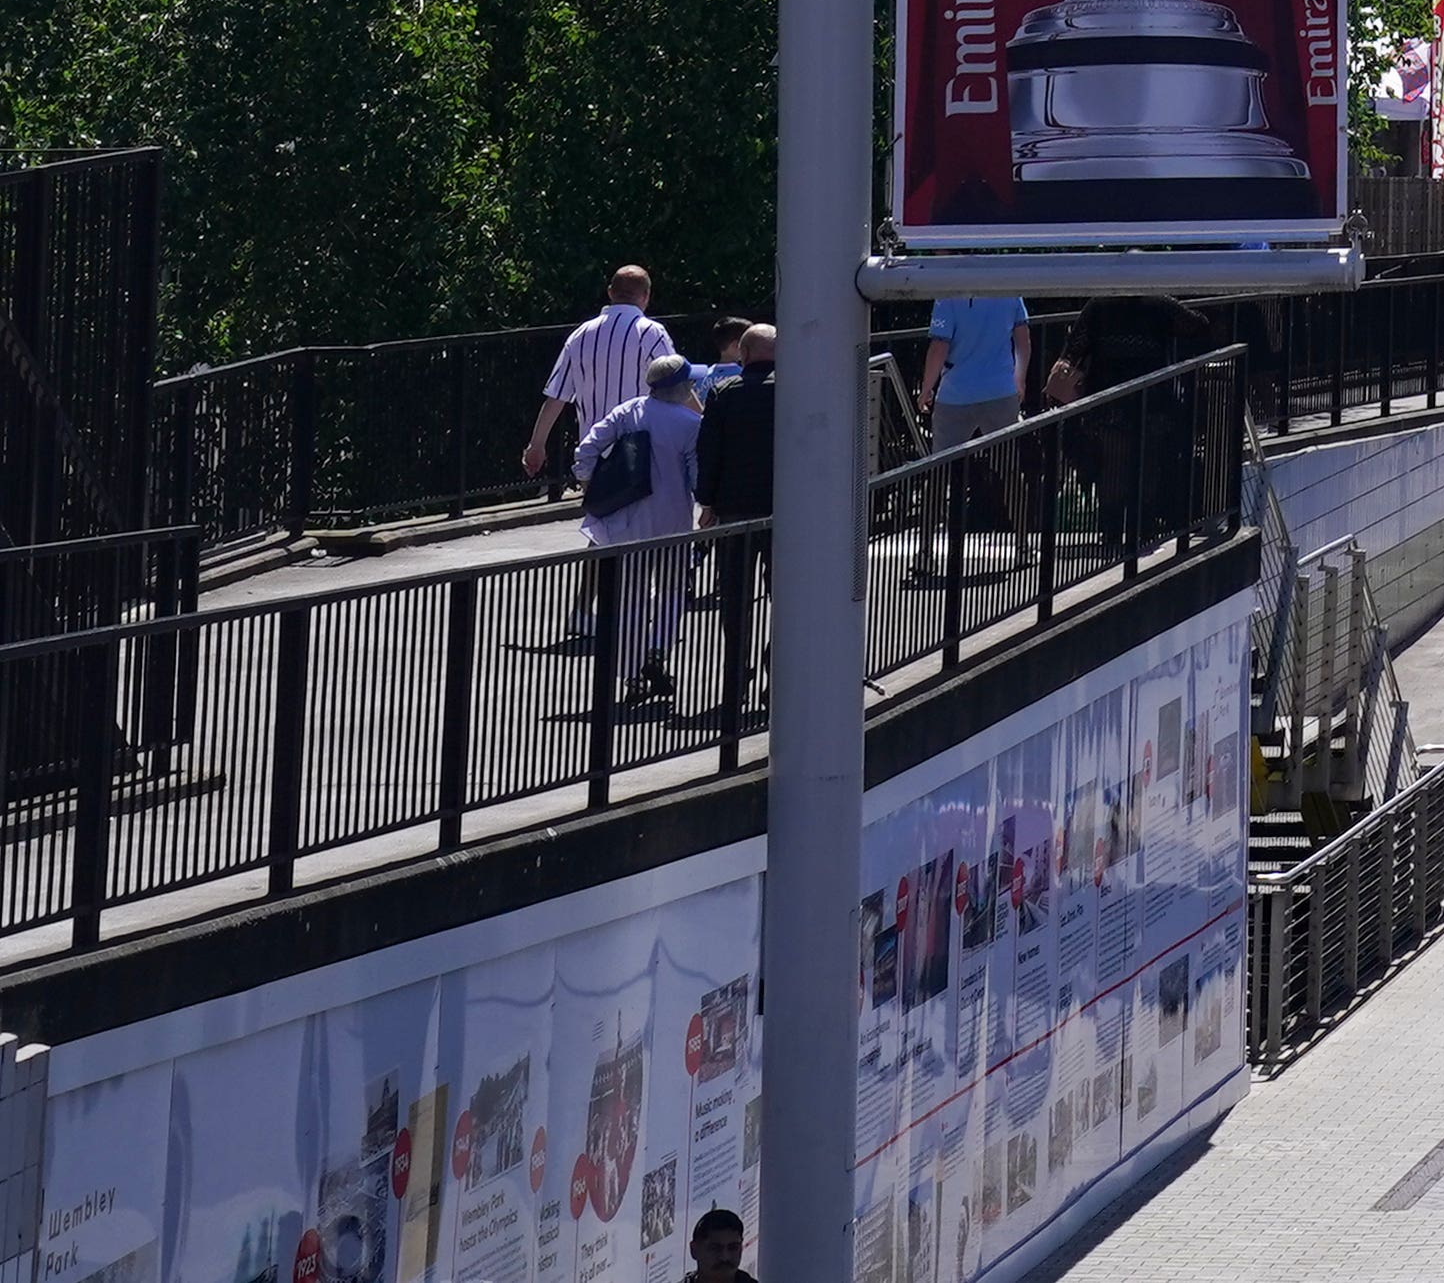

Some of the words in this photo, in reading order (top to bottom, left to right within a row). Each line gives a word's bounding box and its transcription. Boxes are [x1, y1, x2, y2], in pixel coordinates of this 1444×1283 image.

[49, 1187, 116, 1240] Wembley
[44, 1241, 80, 1281] Park
[296, 1253, 317, 1278] 1923
